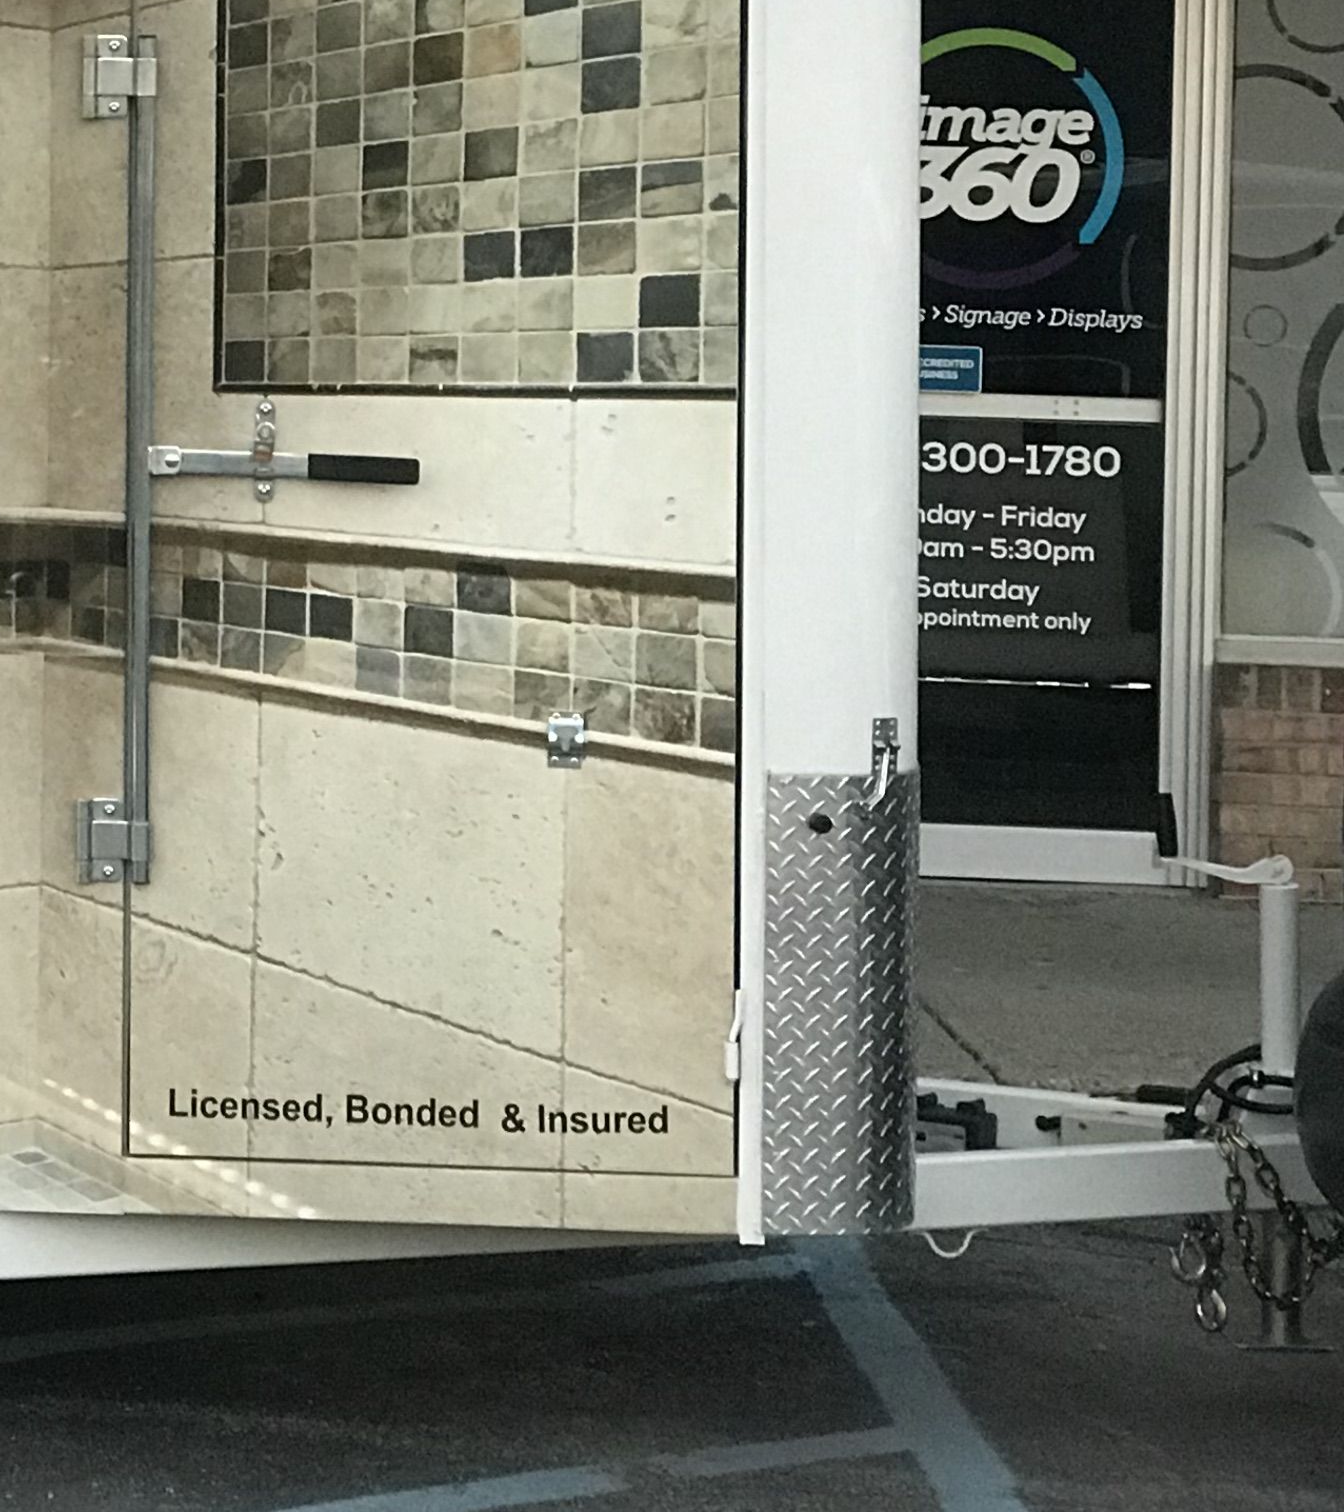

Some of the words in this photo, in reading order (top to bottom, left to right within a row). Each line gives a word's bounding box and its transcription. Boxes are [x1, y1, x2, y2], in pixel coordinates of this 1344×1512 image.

[944, 304, 1032, 329] Signage
[1048, 307, 1144, 333] Displays
[921, 441, 1121, 477] 300-1780
[1001, 505, 1087, 534] Friday
[990, 538, 1095, 566] 5:30pm
[918, 576, 1040, 606] Saturday
[1044, 612, 1092, 635] only
[168, 1088, 333, 1128] Licensed,
[345, 1094, 480, 1128] Bonded
[500, 1103, 526, 1134] &
[538, 1104, 670, 1134] Insured
